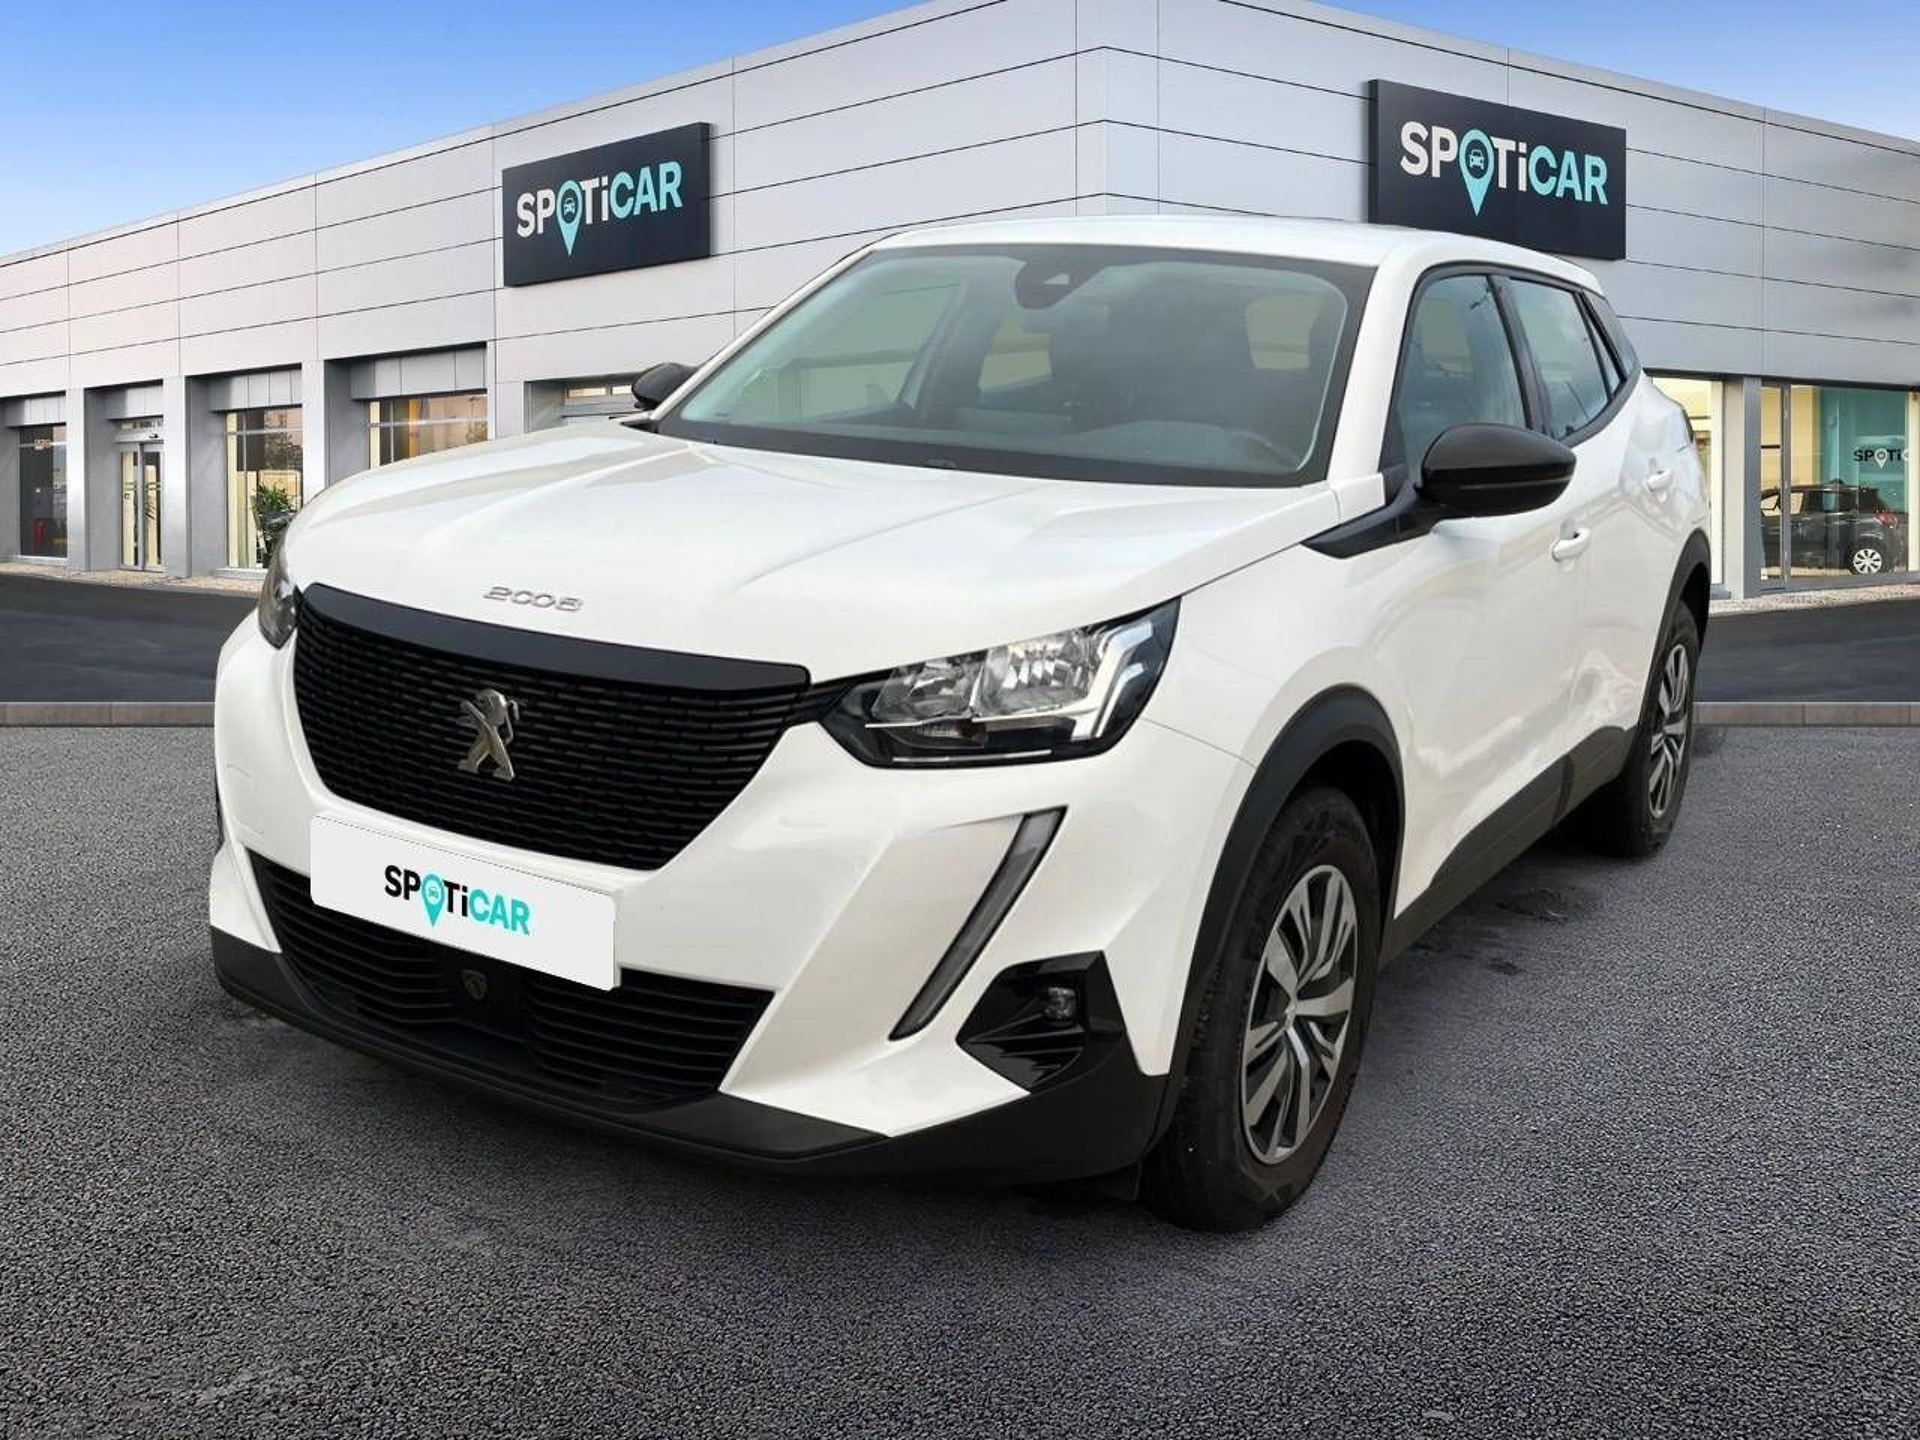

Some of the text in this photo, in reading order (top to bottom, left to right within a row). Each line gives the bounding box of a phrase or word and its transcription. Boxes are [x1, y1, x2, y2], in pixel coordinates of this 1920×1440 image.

[516, 161, 683, 256] SPOTiCAR
[1400, 121, 1608, 216] SPOTiCAR
[483, 586, 583, 612] 2008
[384, 865, 530, 935] SPOTiCAR
